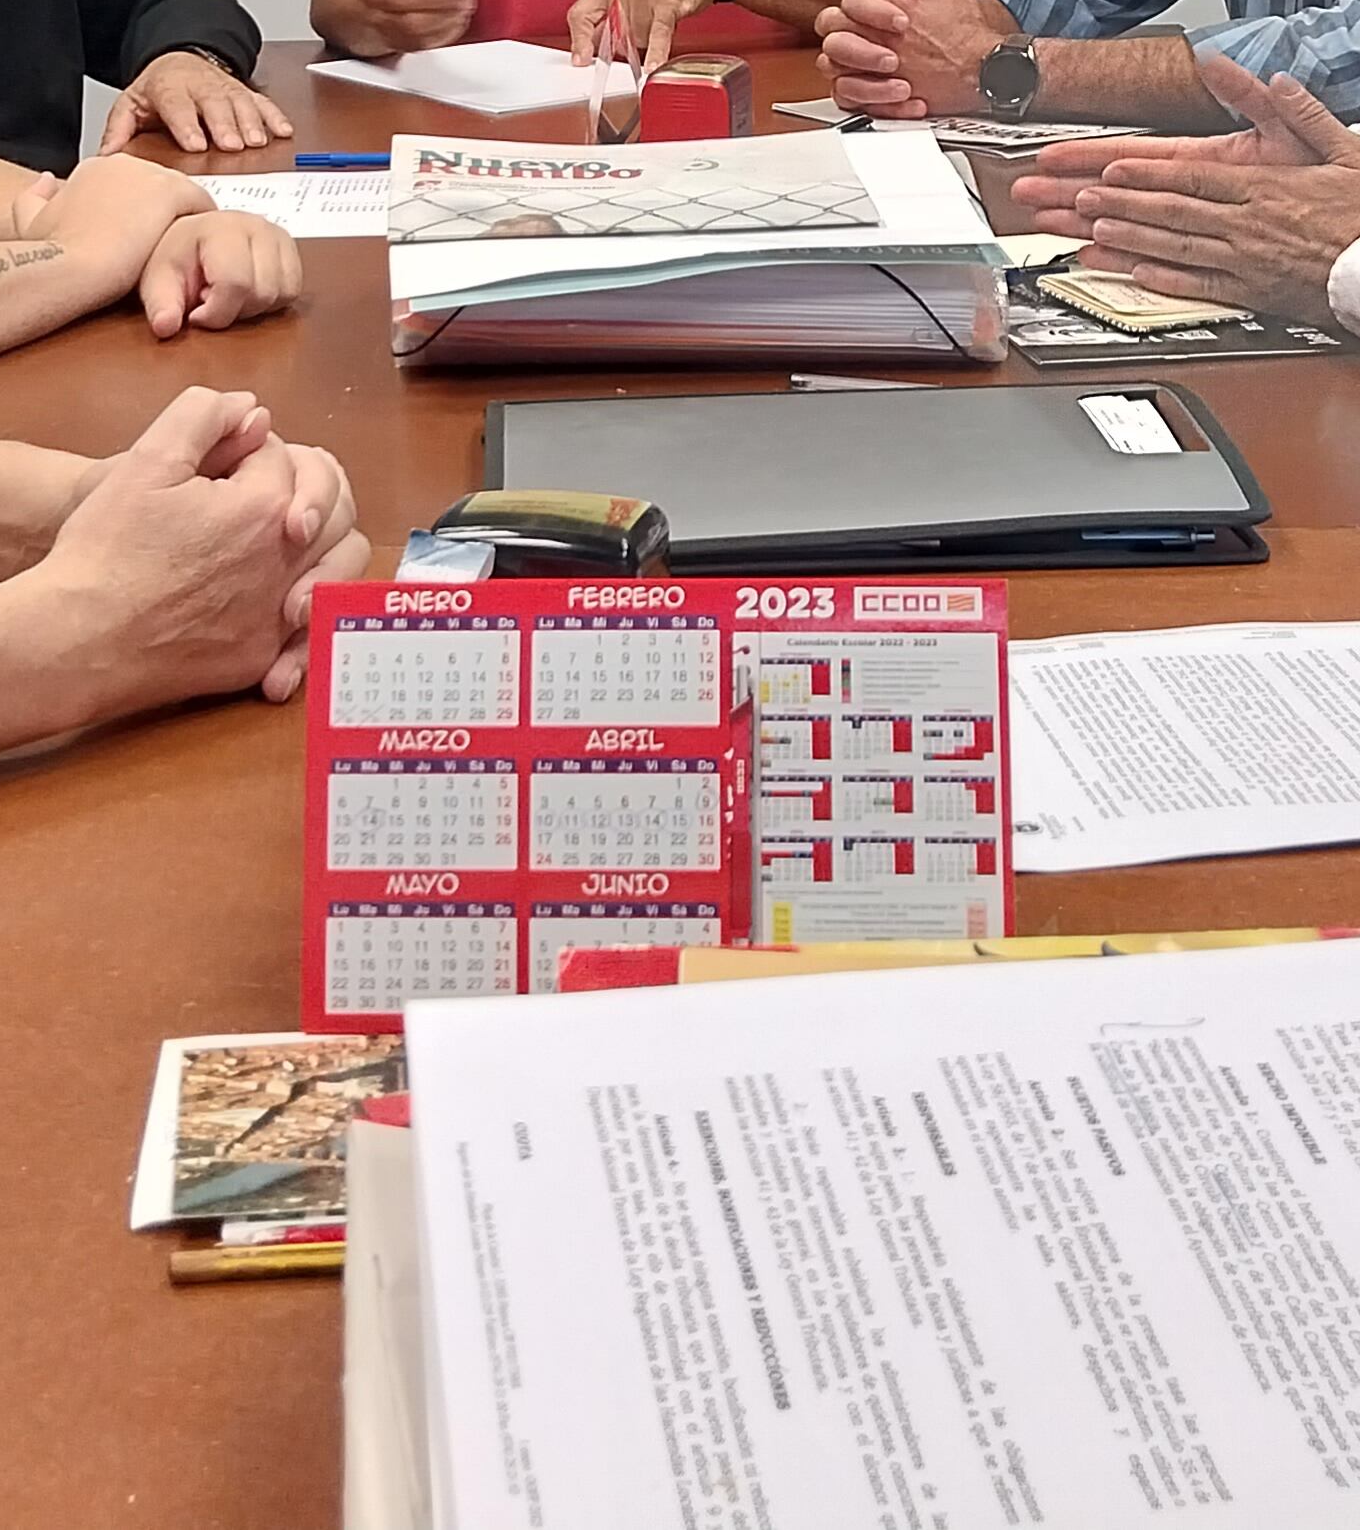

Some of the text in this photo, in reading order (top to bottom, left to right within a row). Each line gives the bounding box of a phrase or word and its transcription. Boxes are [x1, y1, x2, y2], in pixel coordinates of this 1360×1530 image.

[415, 150, 612, 171] Nuevo
[416, 158, 644, 180] Rumbo
[384, 589, 473, 614] ENERO
[568, 586, 685, 610] FEBRERO
[735, 586, 835, 619] 2023
[862, 594, 940, 611] CCOO
[787, 638, 938, 647] Calendario Escolar 2022 2023
[542, 652, 714, 664] 6 7 8 9 10 11 12
[539, 670, 714, 682] 13 14 15 16 17 18 19
[378, 729, 471, 752] MARZO
[584, 728, 665, 752] ABRIL
[385, 872, 460, 897] MAYO
[581, 872, 670, 897] JUNIO
[1257, 1062, 1327, 1165] HECHO IMPONIBLE
[1066, 1076, 1126, 1176] SUJETOS PASIVOS
